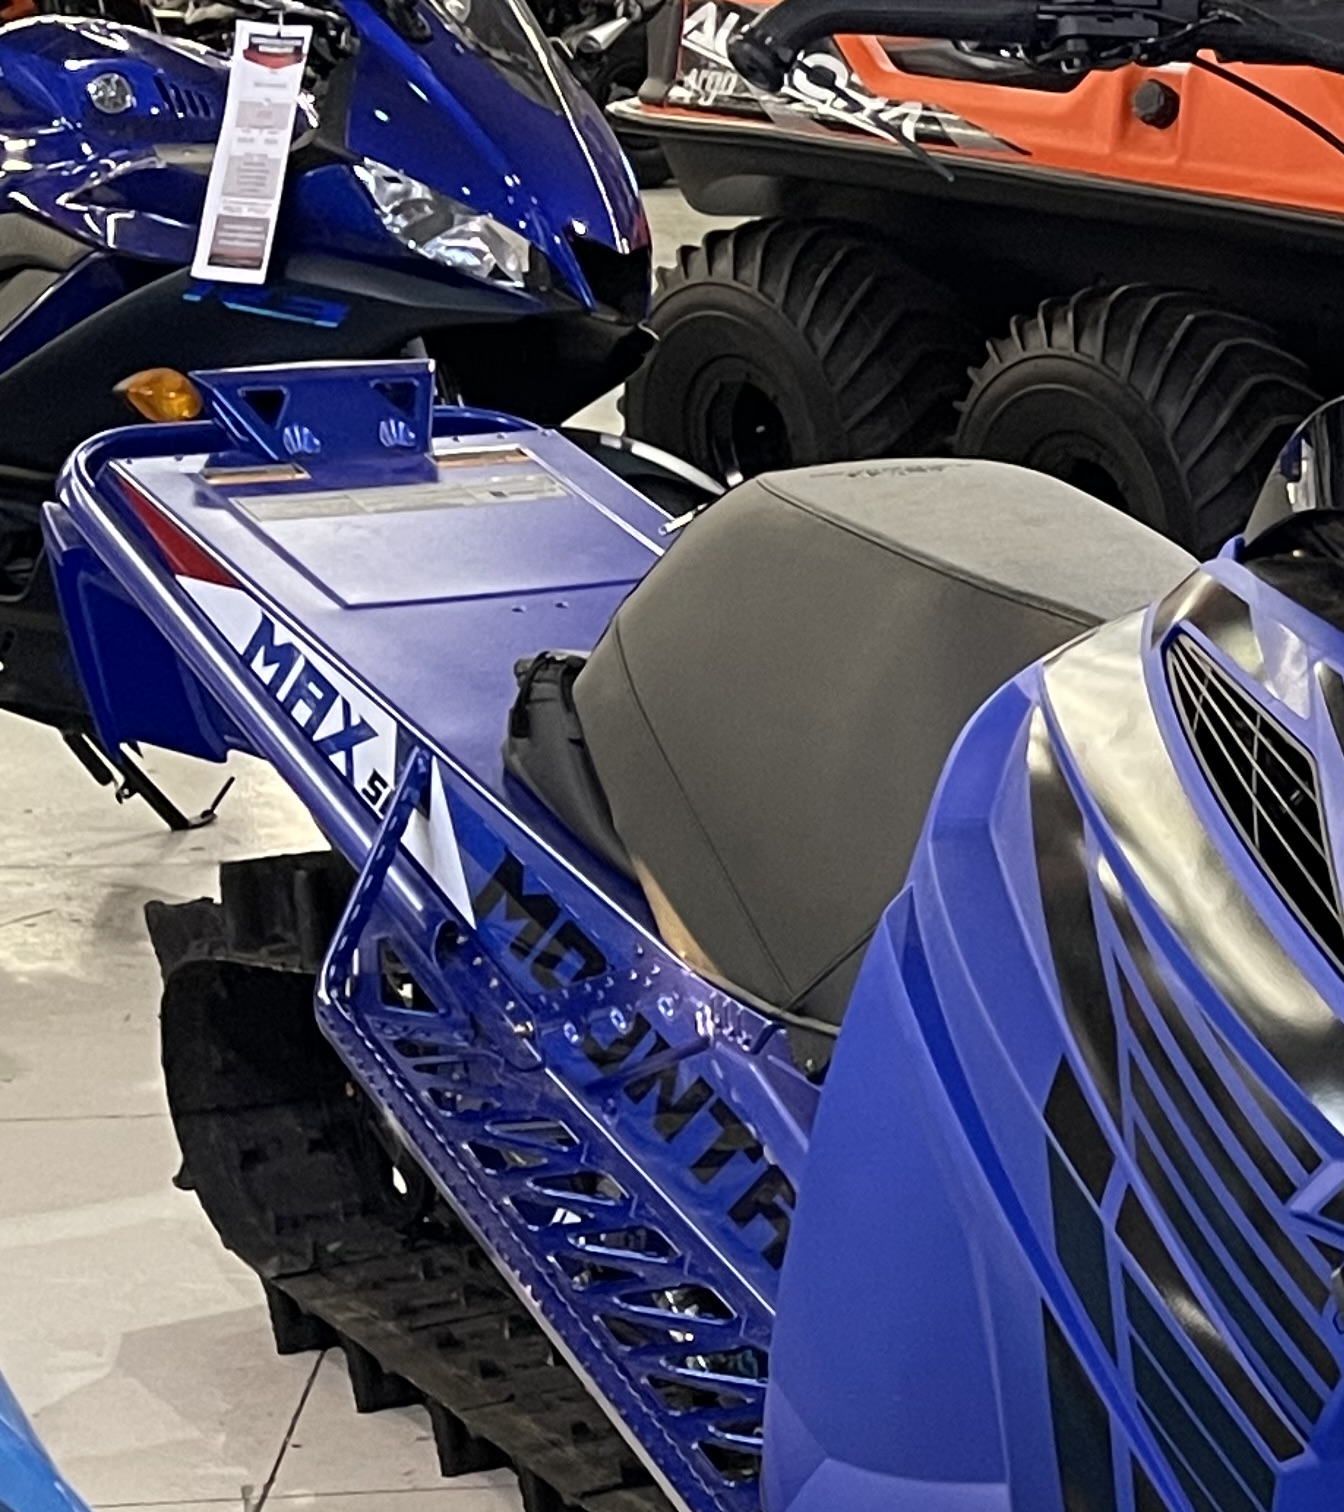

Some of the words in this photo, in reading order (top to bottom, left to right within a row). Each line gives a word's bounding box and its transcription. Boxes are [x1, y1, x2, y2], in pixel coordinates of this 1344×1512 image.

[239, 609, 379, 788] MAX
[361, 767, 397, 821] S
[474, 845, 797, 1271] MOUNTA
